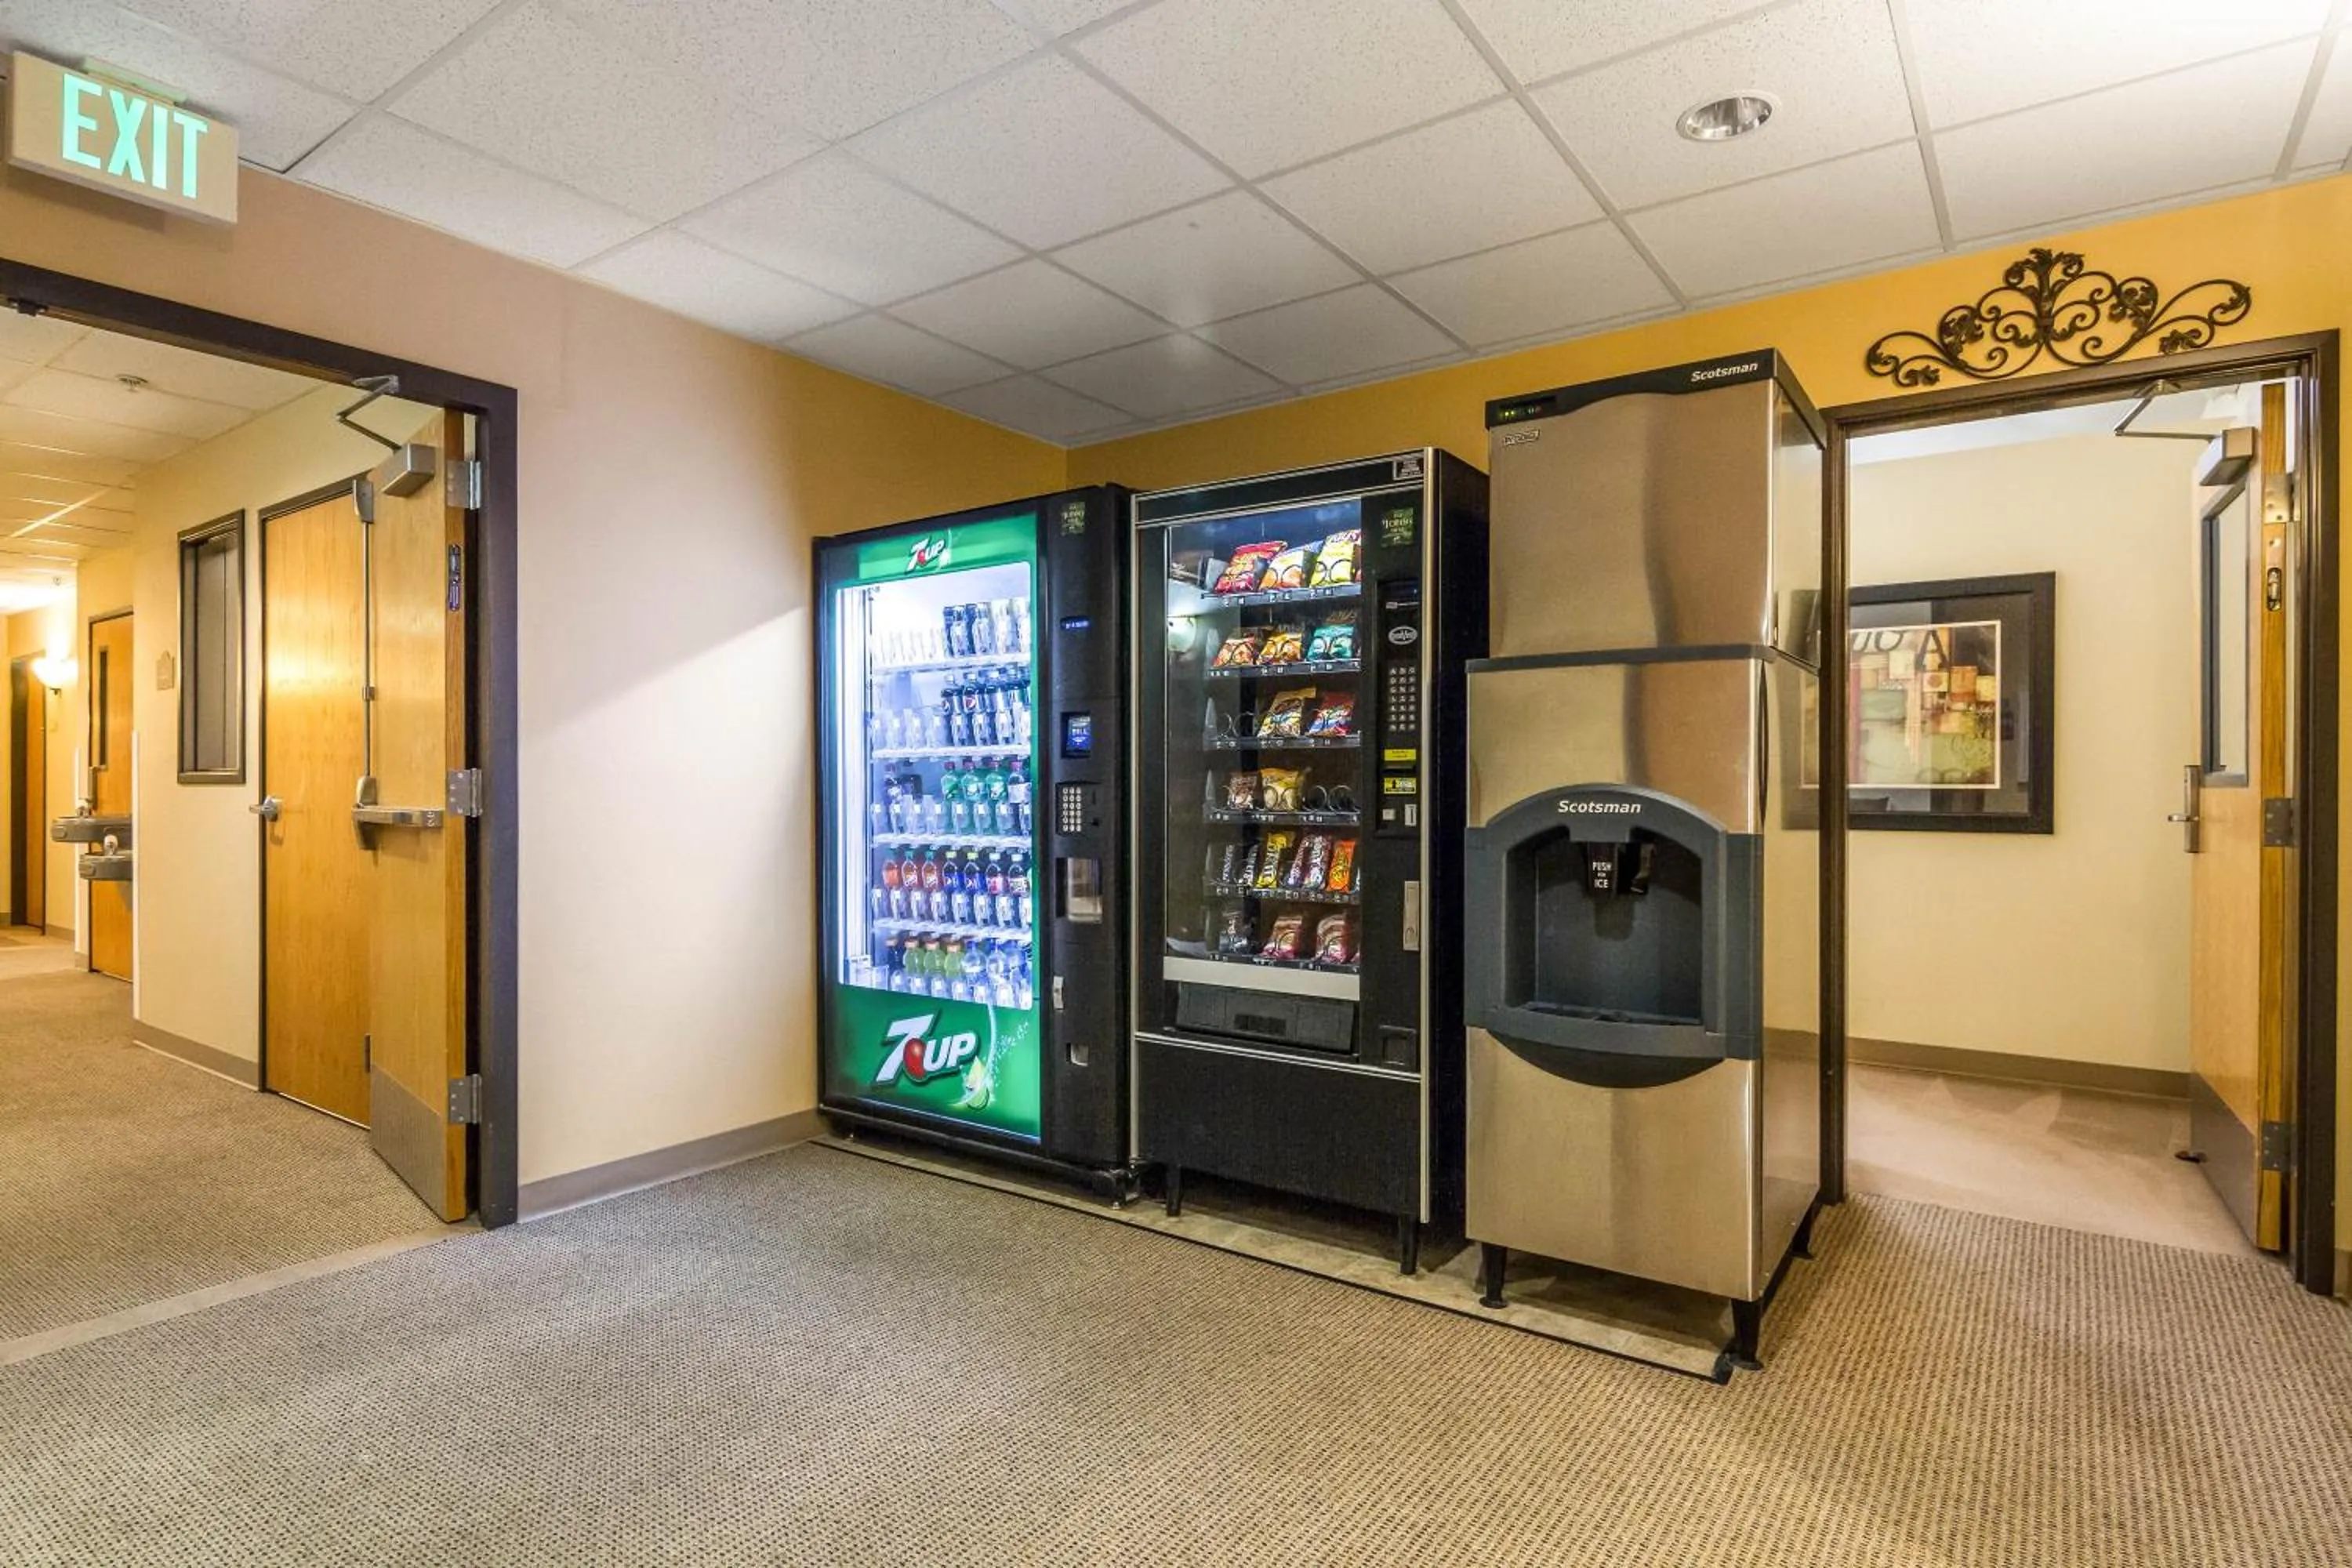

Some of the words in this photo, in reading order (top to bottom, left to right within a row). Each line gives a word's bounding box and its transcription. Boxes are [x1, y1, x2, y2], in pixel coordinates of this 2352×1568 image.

[62, 73, 208, 199] EXIT
[1690, 362, 1759, 382] Scotsman
[1558, 800, 1642, 813] Scotsman
[1594, 879, 1609, 888] ICE
[875, 1014, 978, 1083] 7UP
